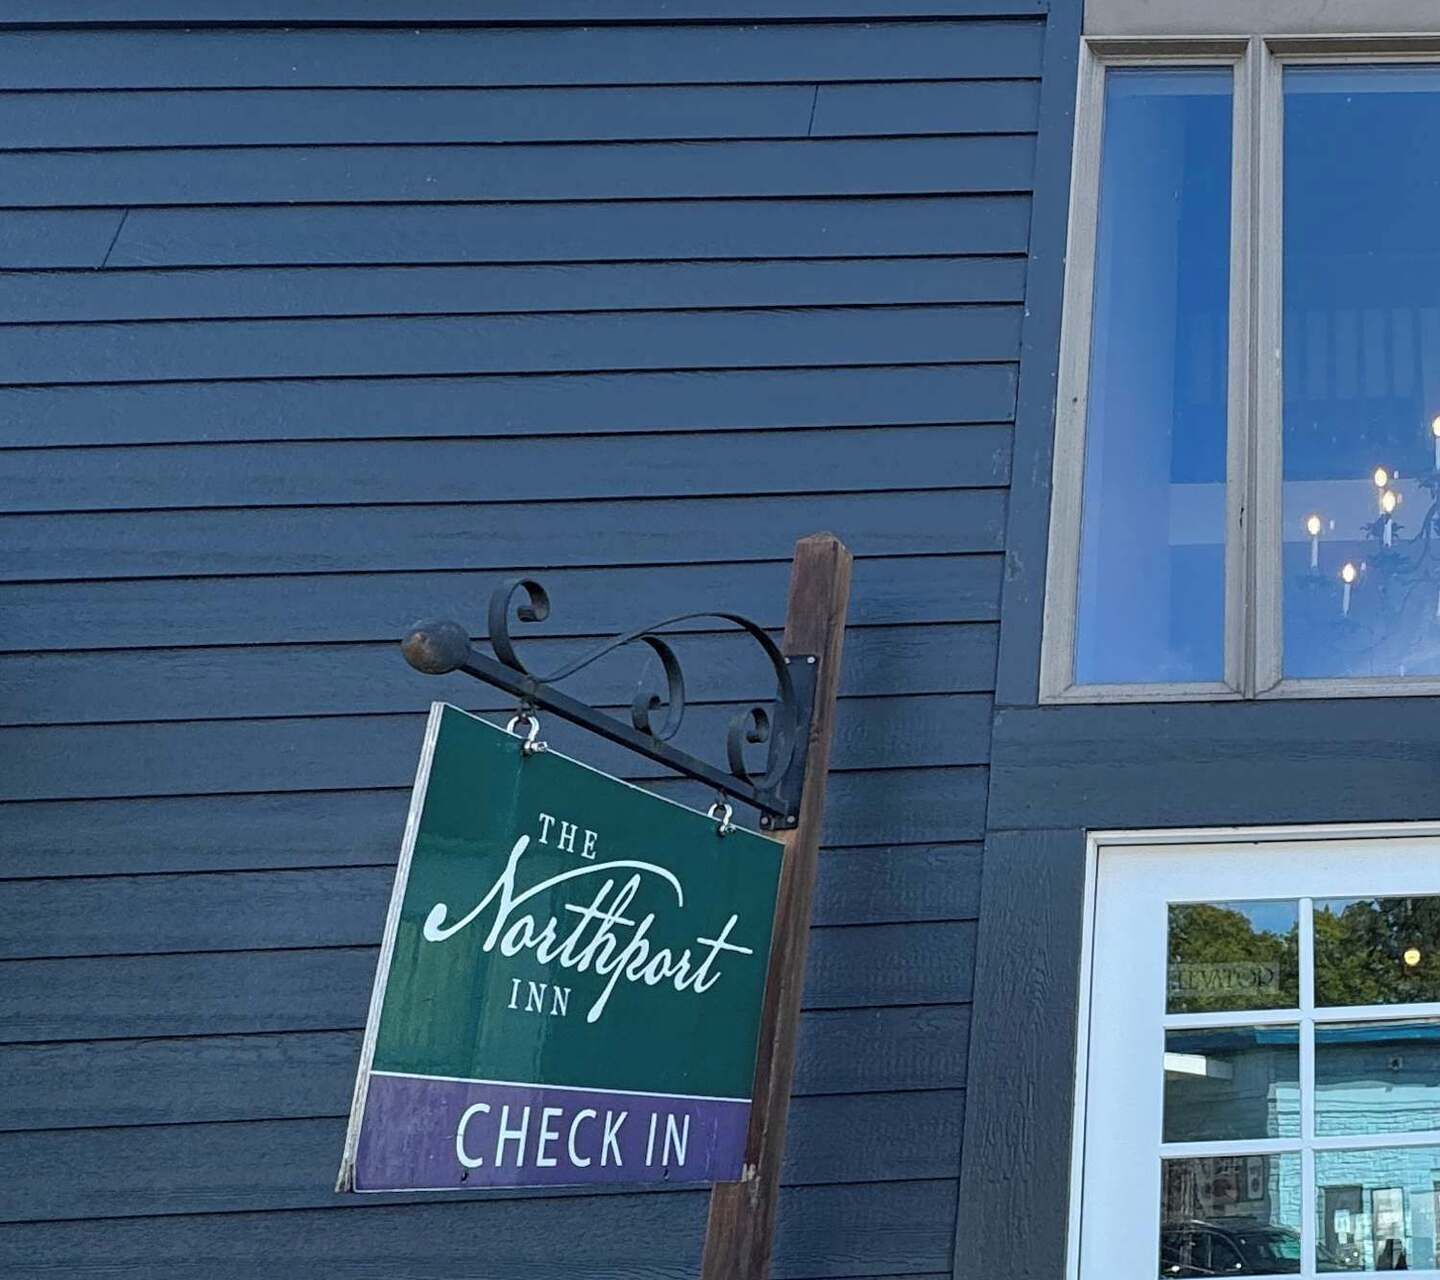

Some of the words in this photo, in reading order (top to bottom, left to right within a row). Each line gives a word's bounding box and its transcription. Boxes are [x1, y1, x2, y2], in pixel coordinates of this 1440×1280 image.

[538, 813, 598, 860] THE
[423, 834, 753, 1024] Northport
[508, 978, 571, 1017] INN
[456, 1103, 629, 1169] CHECK
[645, 1112, 691, 1167] IN
